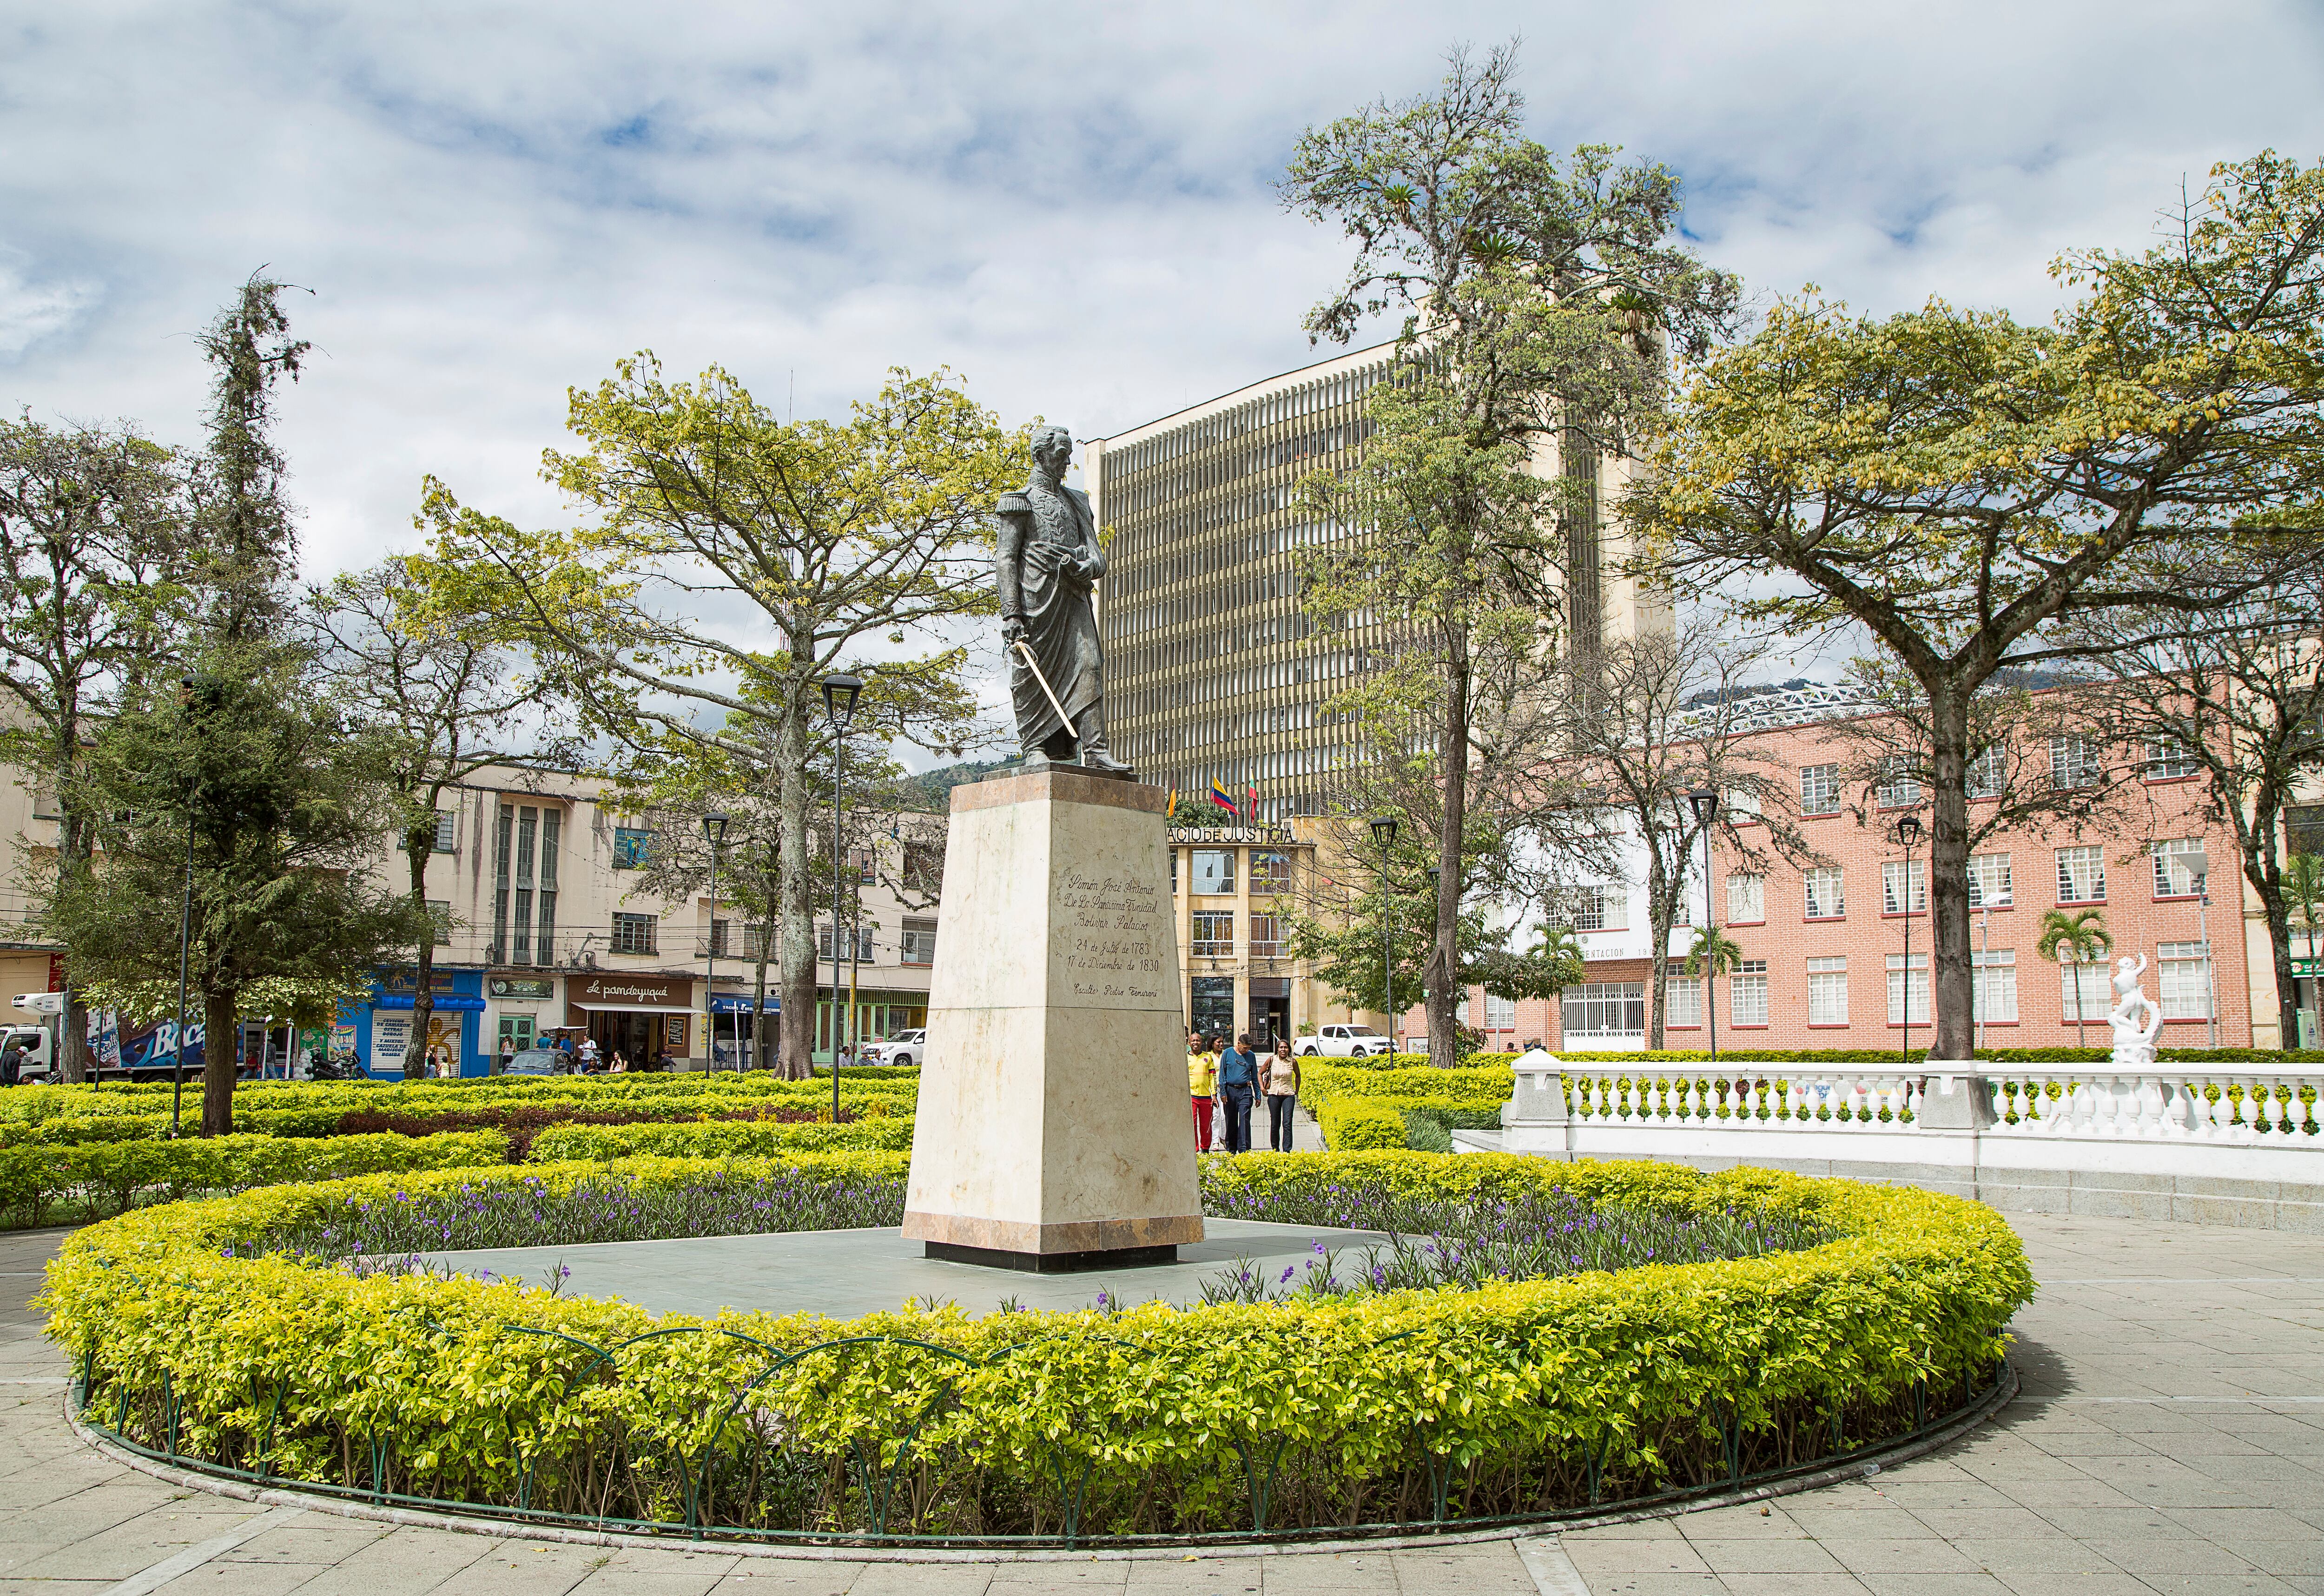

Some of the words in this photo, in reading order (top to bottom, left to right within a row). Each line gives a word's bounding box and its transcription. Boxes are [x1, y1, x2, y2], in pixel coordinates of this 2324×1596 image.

[1168, 827, 1201, 842] ACIO
[1224, 827, 1295, 843] JUSTICIA
[1069, 874, 1098, 890] Simón
[1100, 878, 1122, 895] José
[1124, 880, 1155, 894] Antonio
[1064, 893, 1077, 907] De
[1078, 895, 1089, 908] La
[1126, 899, 1156, 913] Trinidad
[1115, 915, 1148, 930] Palacios
[1077, 939, 1087, 951] 24
[1091, 941, 1098, 952] de
[1100, 941, 1119, 956] Julio
[1122, 942, 1129, 954] de
[1131, 943, 1149, 954] 1783
[1586, 948, 1624, 958] ENTACION
[1068, 955, 1076, 967] 17
[1078, 957, 1086, 968] de
[1088, 957, 1122, 970] Diciembre
[1127, 960, 1135, 970] de
[1140, 959, 1159, 972] 1830
[587, 980, 600, 993] Le
[603, 985, 667, 1002] pandeyuqué
[1104, 985, 1124, 995] Pietro
[151, 1023, 205, 1058] Boca
